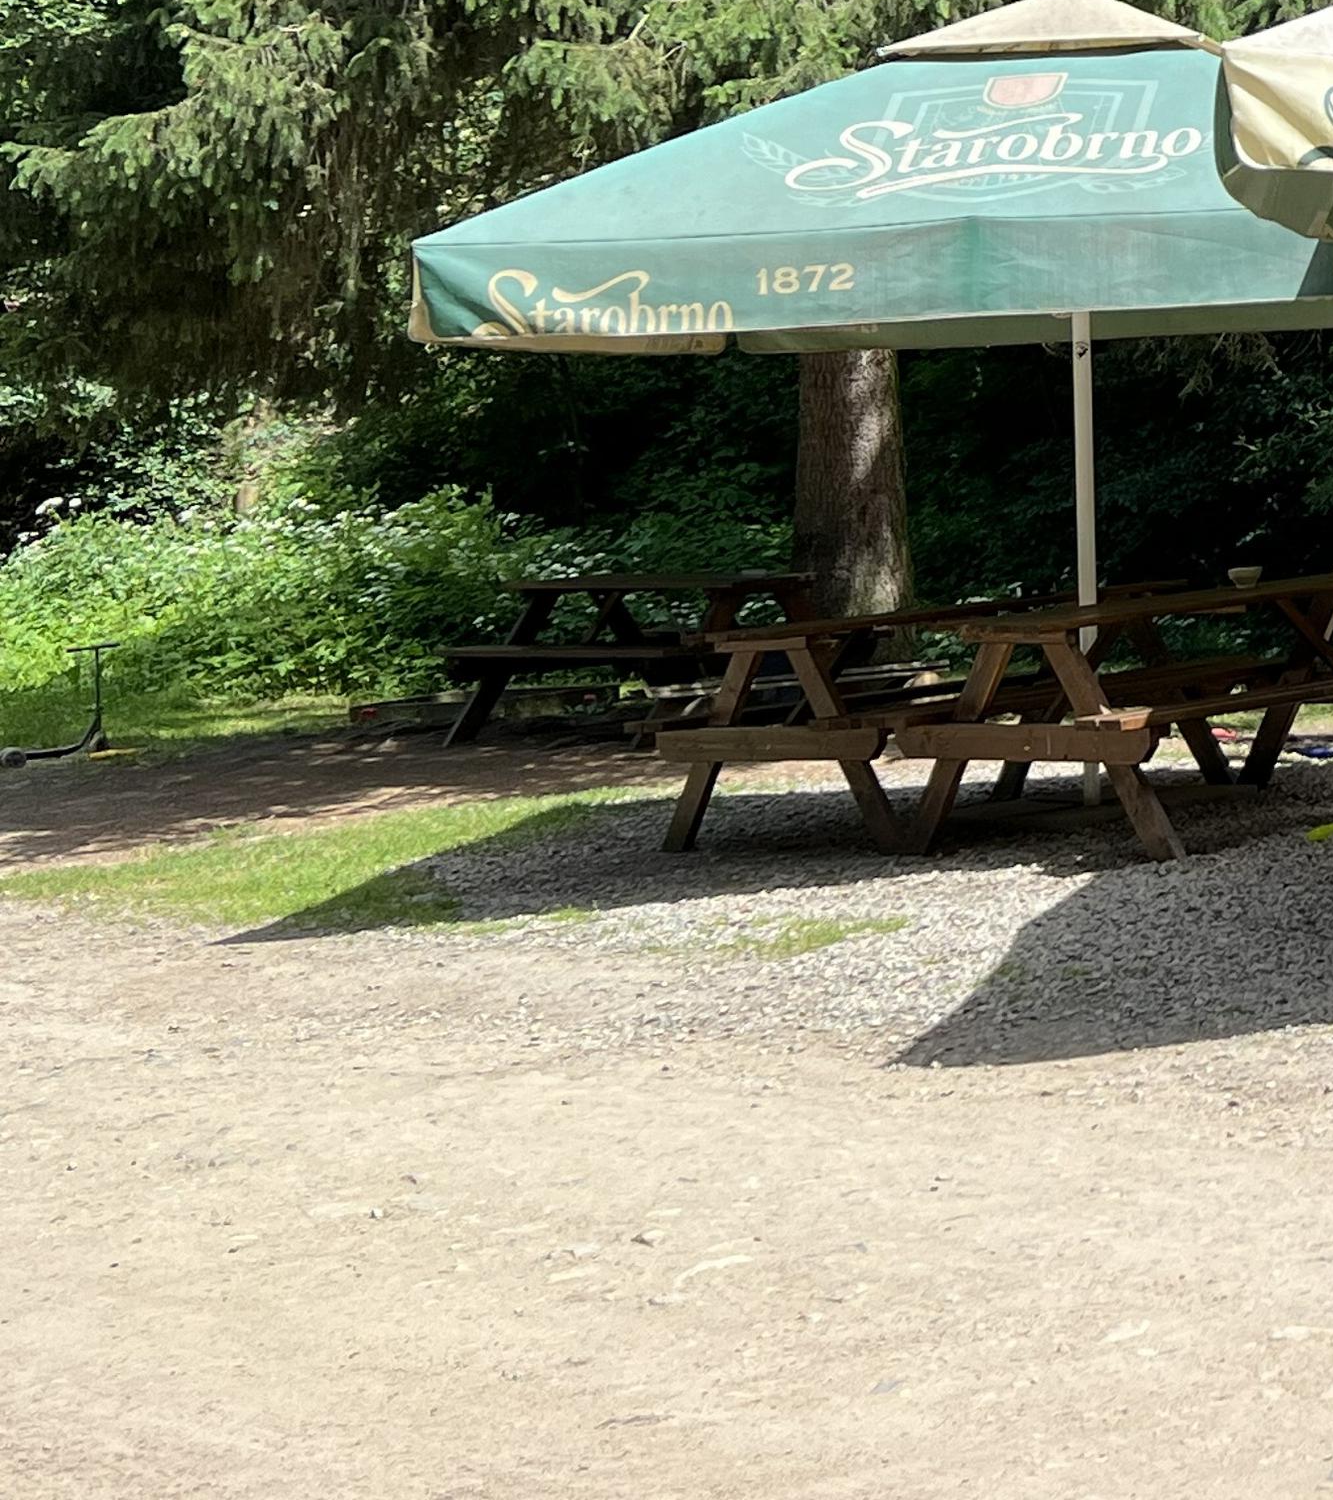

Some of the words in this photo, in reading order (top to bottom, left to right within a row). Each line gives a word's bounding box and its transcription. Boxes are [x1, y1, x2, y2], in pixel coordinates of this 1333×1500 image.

[785, 113, 1202, 198] Starobrno
[471, 269, 734, 336] Starobrno
[756, 263, 856, 295] 1872
